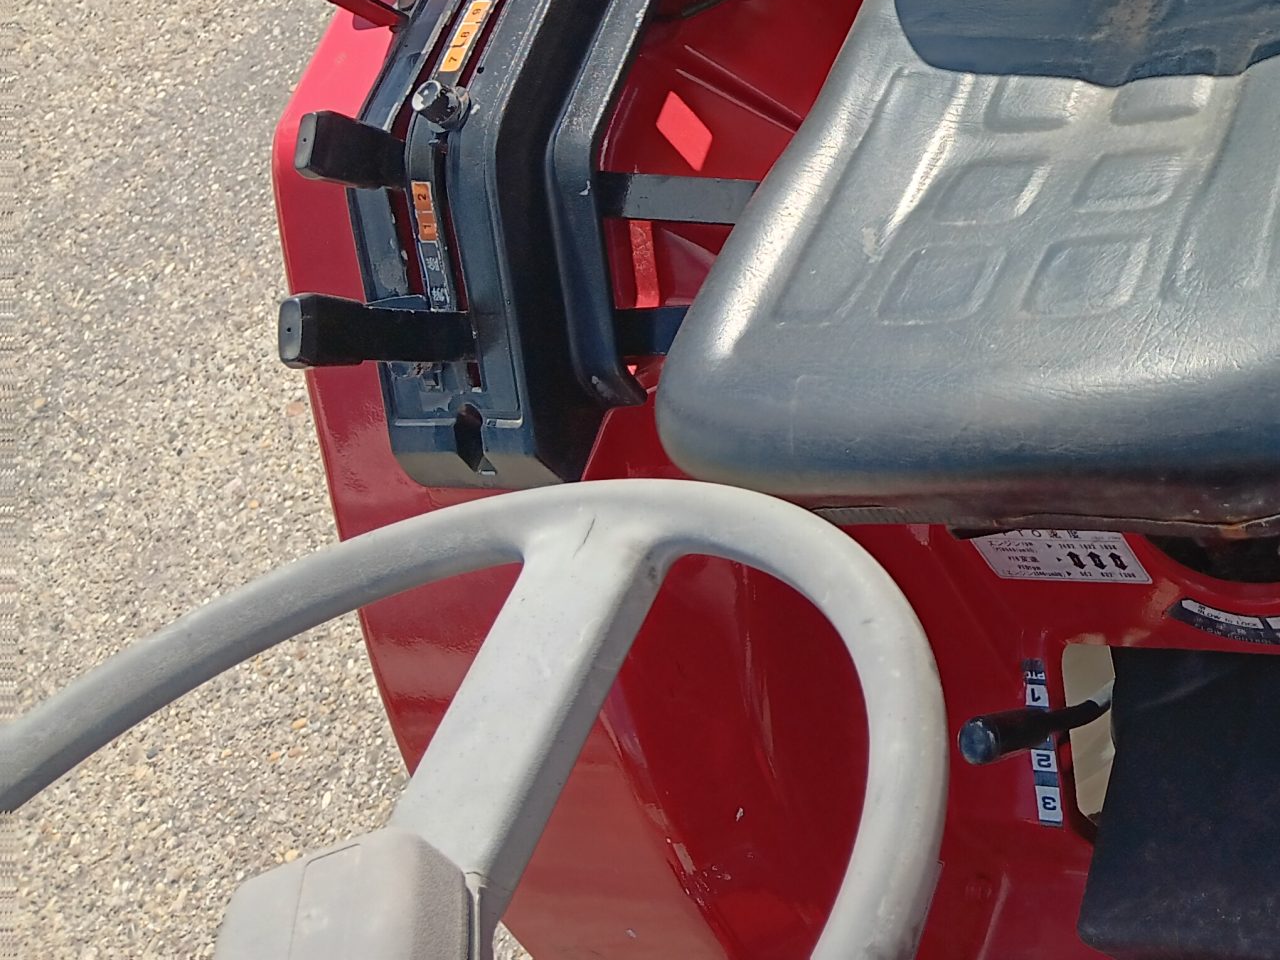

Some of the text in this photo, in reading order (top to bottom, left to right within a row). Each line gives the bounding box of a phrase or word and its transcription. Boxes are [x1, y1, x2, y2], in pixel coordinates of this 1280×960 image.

[417, 192, 427, 201] 2
[1030, 687, 1041, 703] 1
[1035, 753, 1052, 769] 2
[1041, 796, 1057, 811] 3
